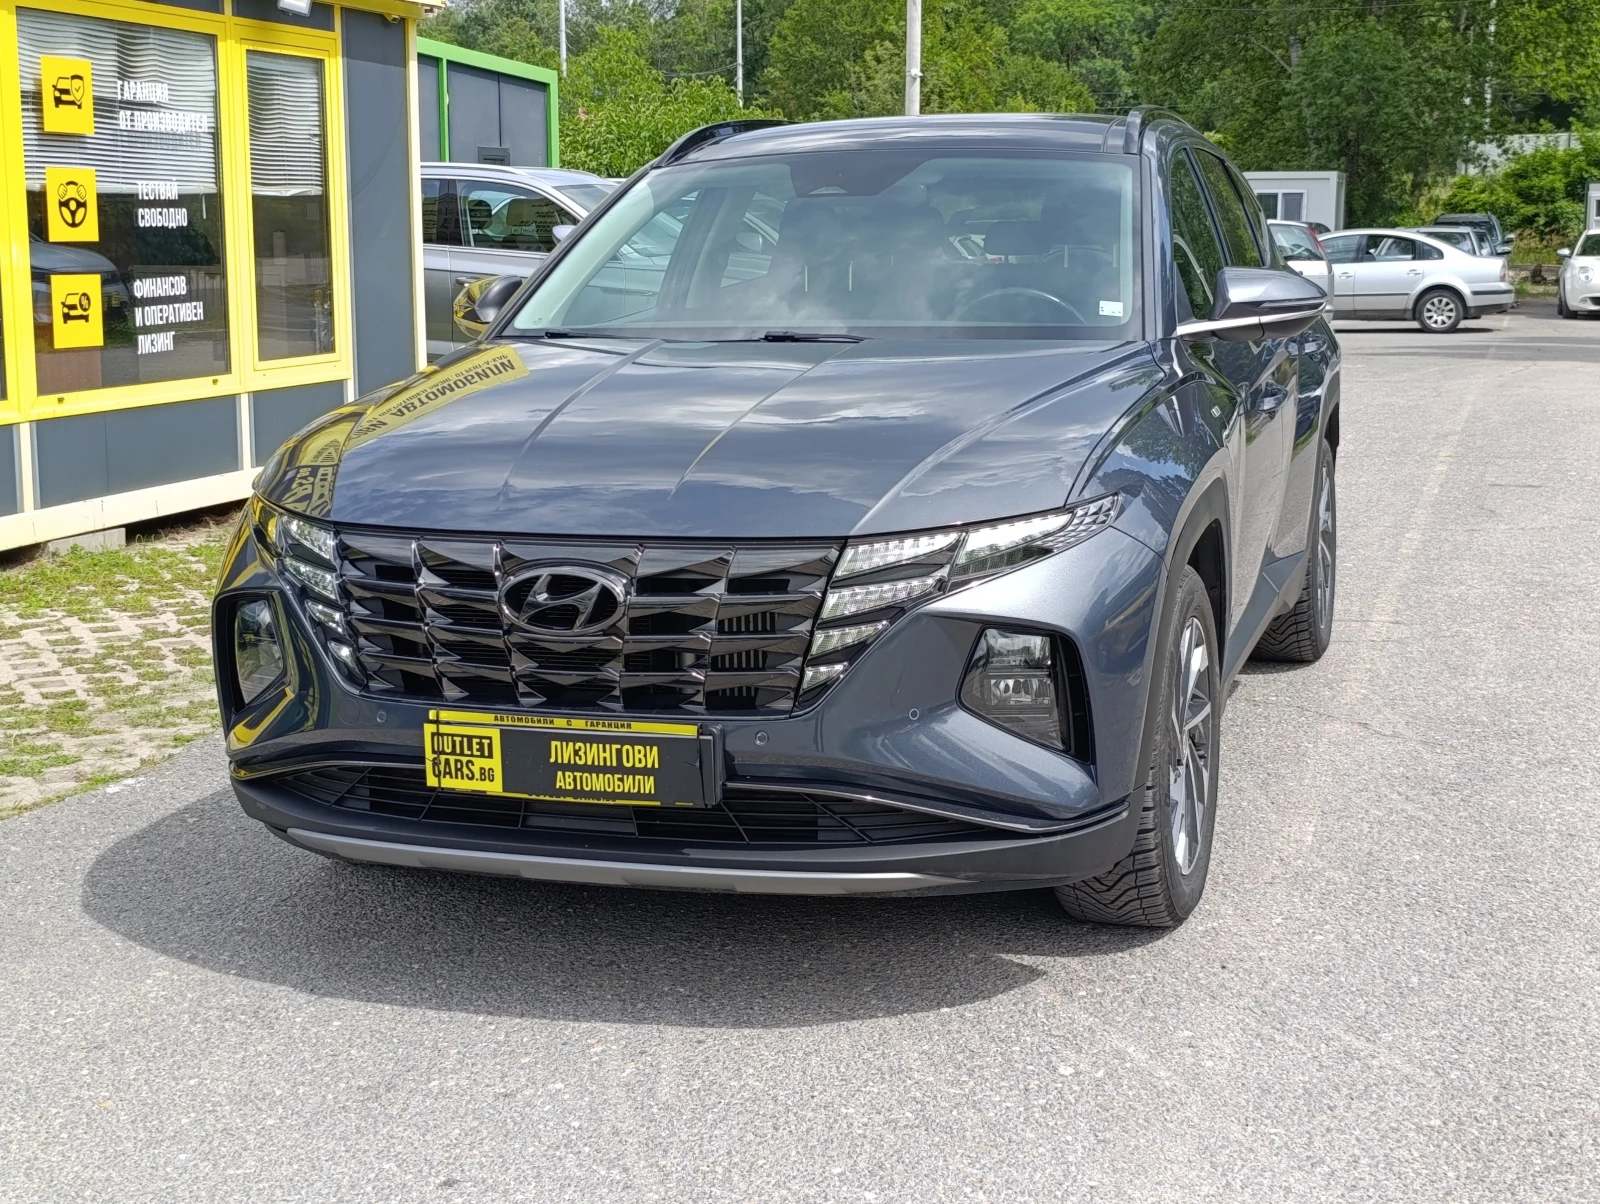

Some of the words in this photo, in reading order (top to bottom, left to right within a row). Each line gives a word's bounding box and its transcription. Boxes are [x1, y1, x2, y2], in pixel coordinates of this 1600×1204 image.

[117, 81, 168, 103] ГАРАНЦИЯ
[120, 111, 131, 129] ОТ
[137, 178, 178, 200] ТЕСТВАЙ
[138, 207, 188, 229] СВОБОДНО
[134, 276, 187, 299] ФИНАНСОВ
[135, 306, 143, 327] И
[144, 301, 204, 326] ОПЕРАТИВЕН
[137, 331, 175, 355] ЛИЗИНГ
[494, 714, 555, 726] АВТОМОБИЛИ
[585, 719, 633, 731] ГАРАНЦИЯ
[433, 735, 491, 757] OUTLET
[549, 740, 660, 769] ЛИЗИНГОВИ
[431, 756, 495, 783] CARS.BG
[555, 771, 656, 795] АВТОМОБИЛИ
